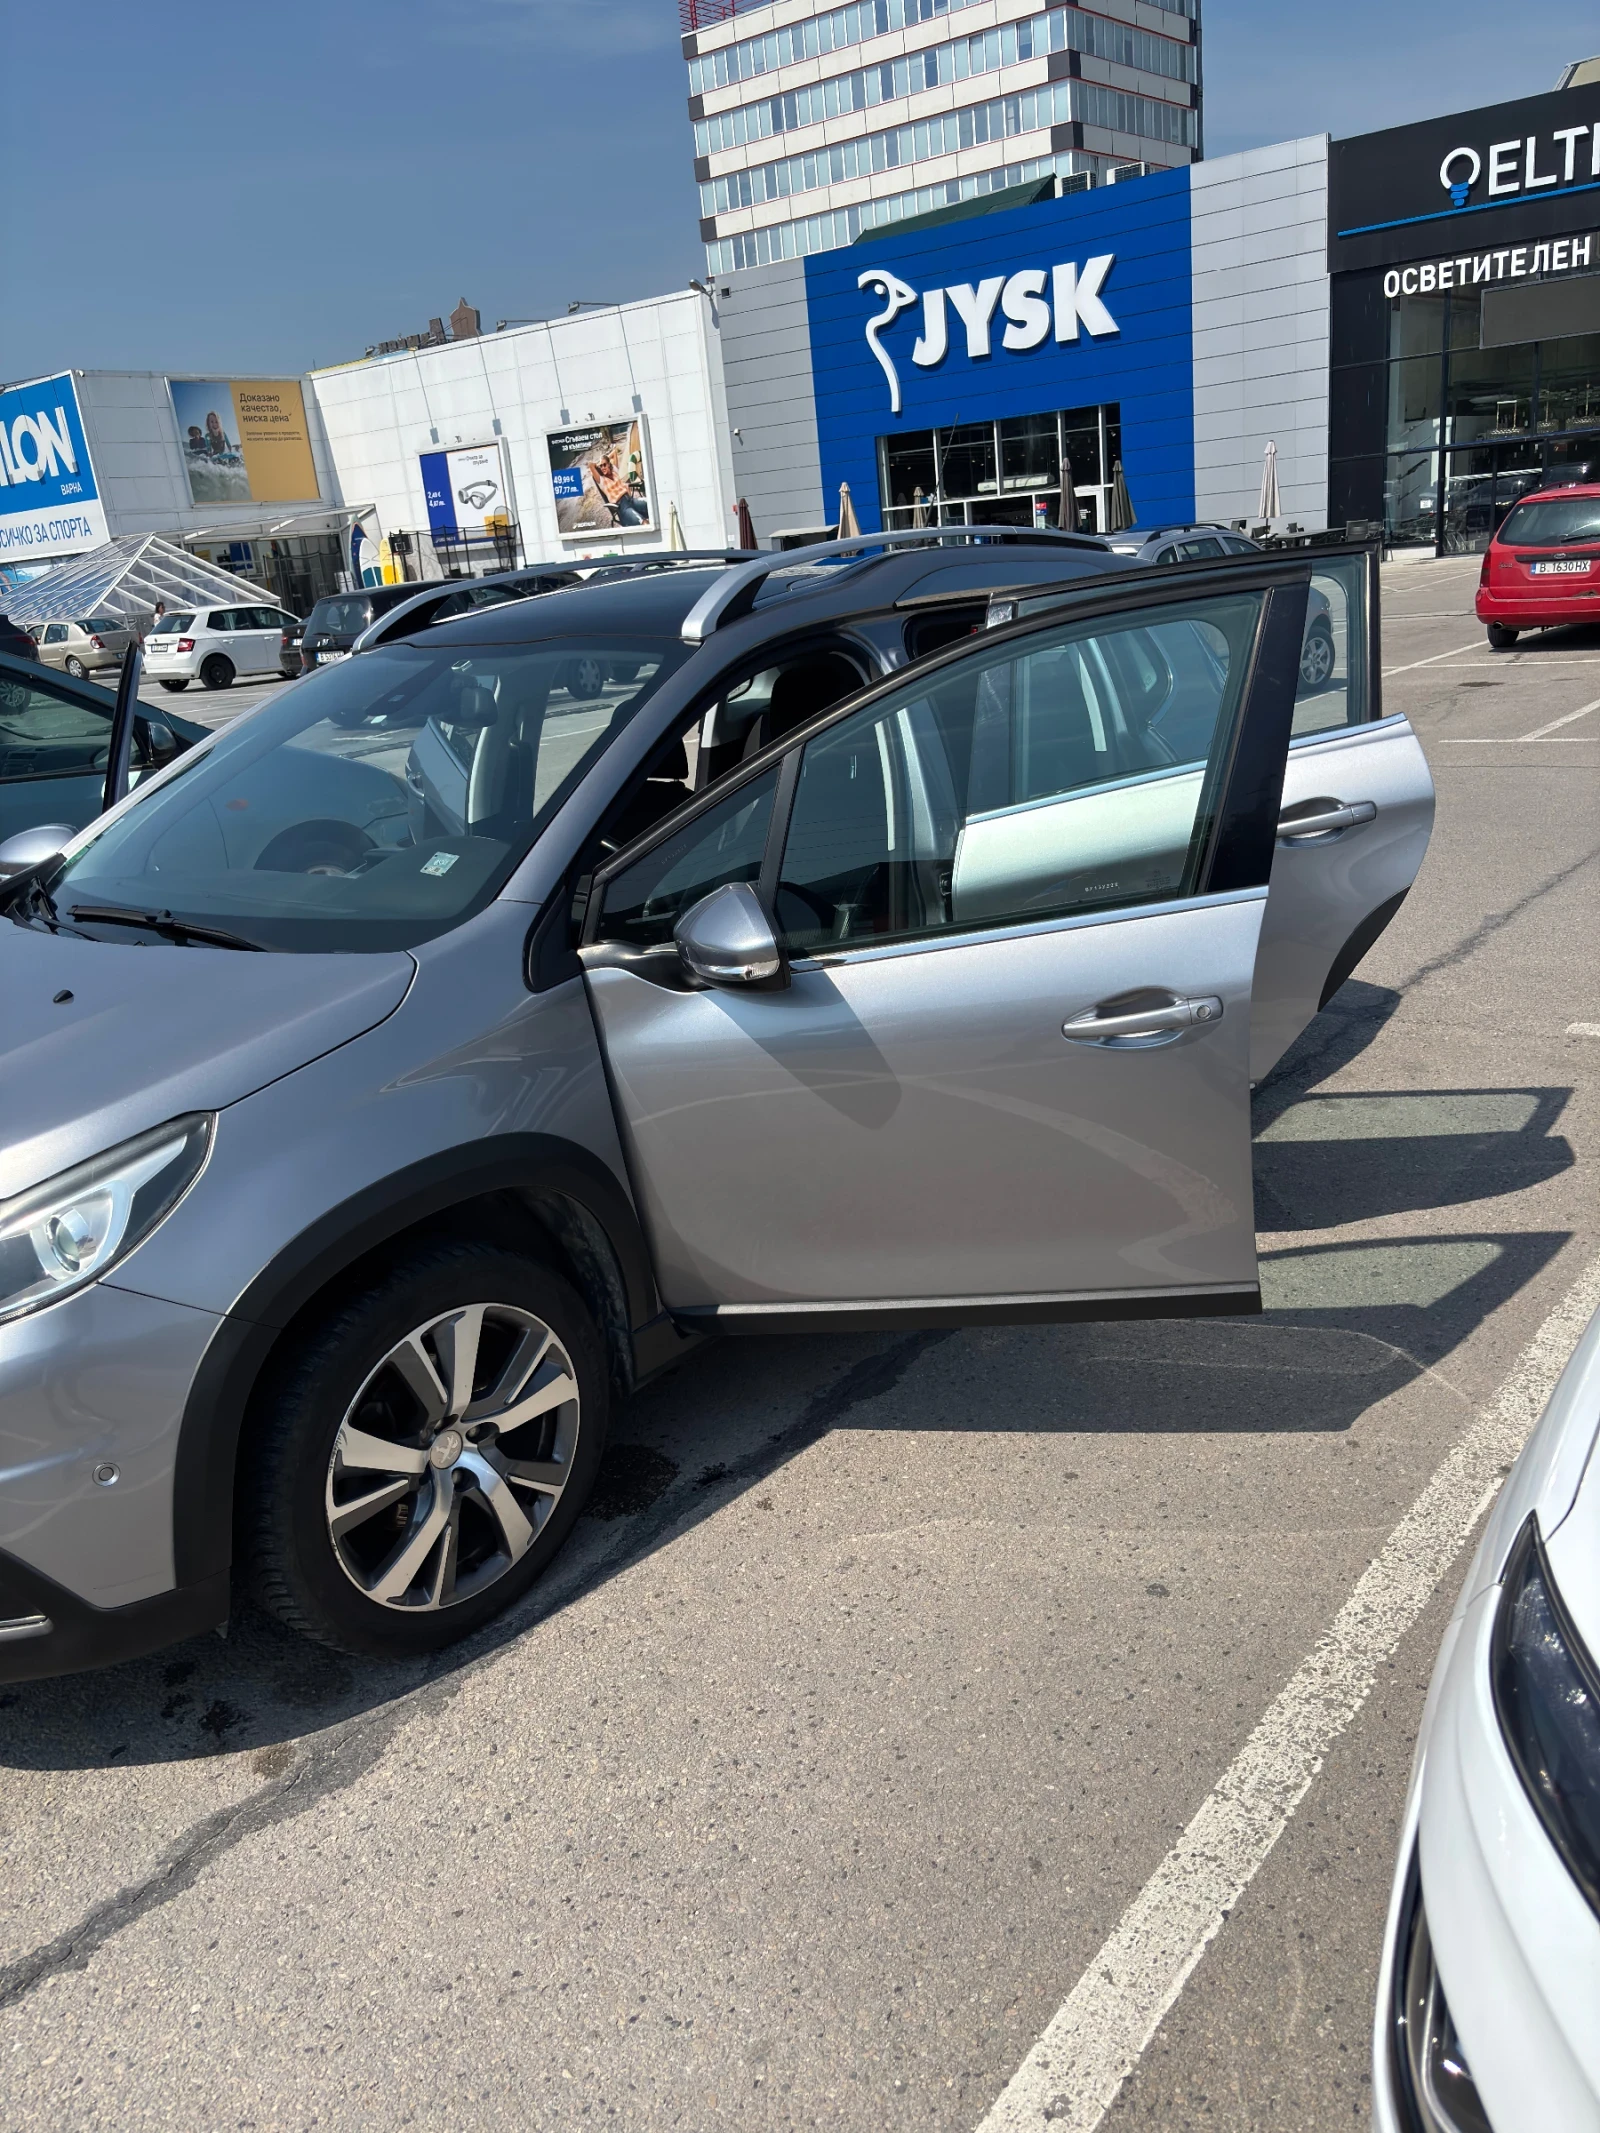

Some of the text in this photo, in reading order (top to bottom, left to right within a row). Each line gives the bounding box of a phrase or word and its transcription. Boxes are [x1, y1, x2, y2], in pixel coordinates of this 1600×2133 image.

[1383, 235, 1591, 299] ОСВЕТИТЕЛЕН
[911, 253, 1121, 366] JYSK
[239, 393, 280, 403] Доказано
[241, 404, 282, 414] качество,
[242, 415, 268, 423] ниска
[589, 432, 603, 440] стол
[60, 481, 83, 496] ВАРНА
[0, 516, 93, 548] СИЧКО ЗА СПОРТА
